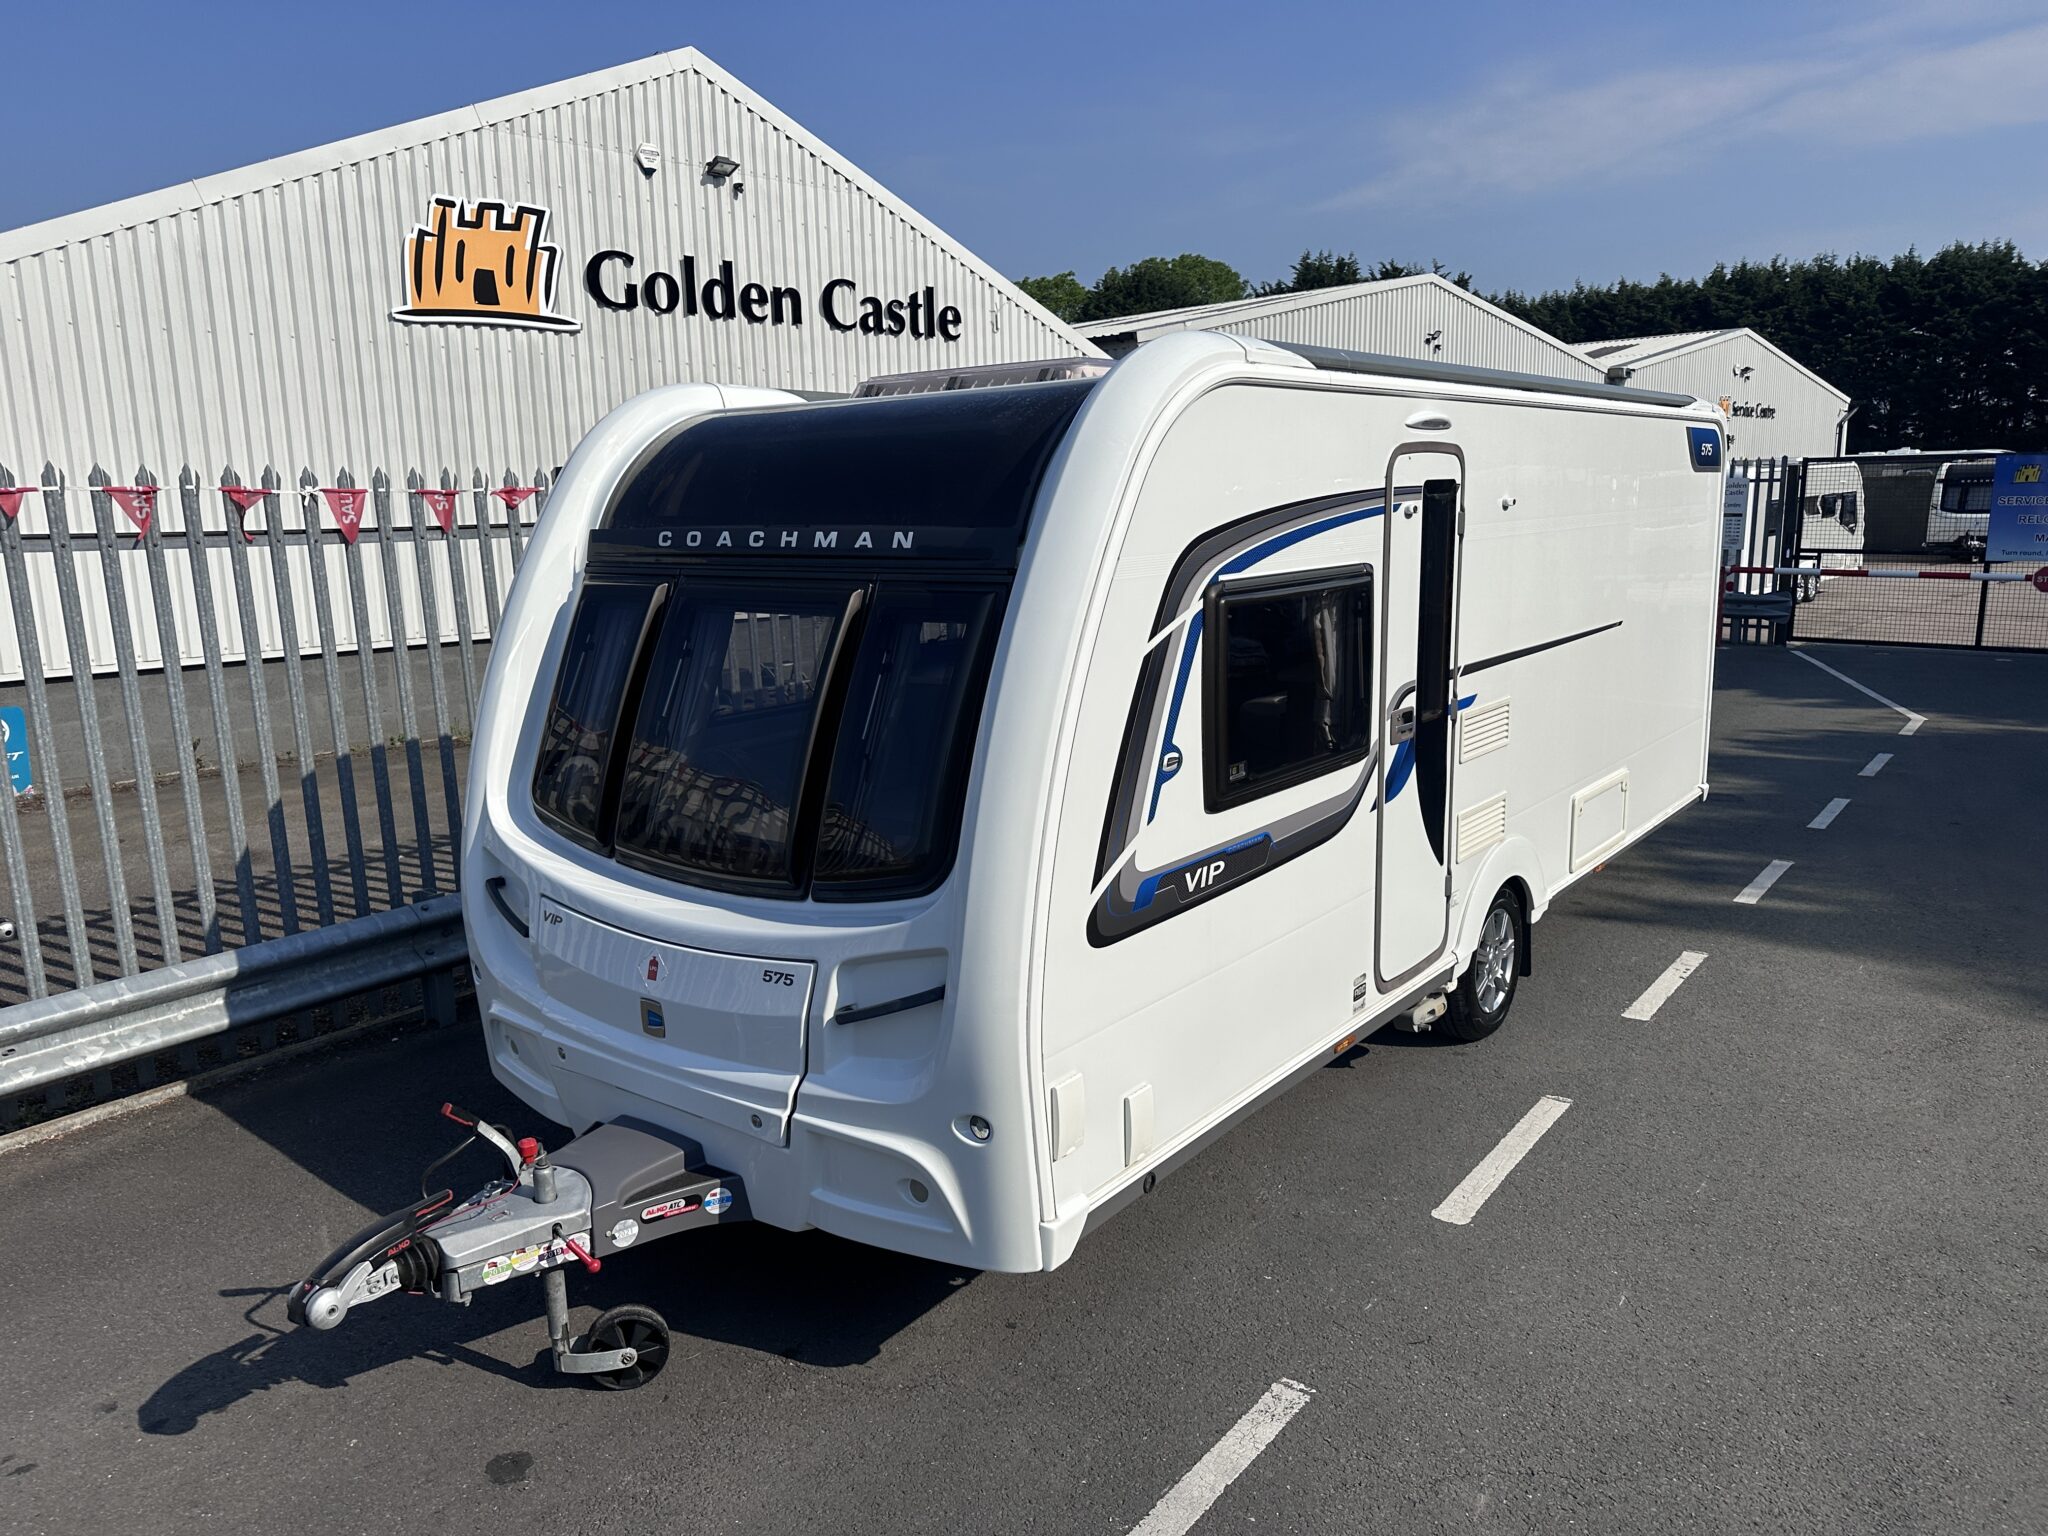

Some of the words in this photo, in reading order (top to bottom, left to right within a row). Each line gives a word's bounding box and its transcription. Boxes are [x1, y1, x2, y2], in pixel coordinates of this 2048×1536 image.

[587, 249, 802, 326] Golden
[822, 278, 962, 341] Castle
[1731, 401, 1755, 418] Service
[1701, 443, 1713, 456] 575
[340, 492, 357, 524] SAL
[658, 530, 914, 549] COACHMAN
[1184, 860, 1226, 893] VIP
[543, 910, 563, 925] VIP
[762, 969, 795, 987] 575
[669, 1200, 684, 1211] ATC
[543, 1248, 562, 1260] 2019
